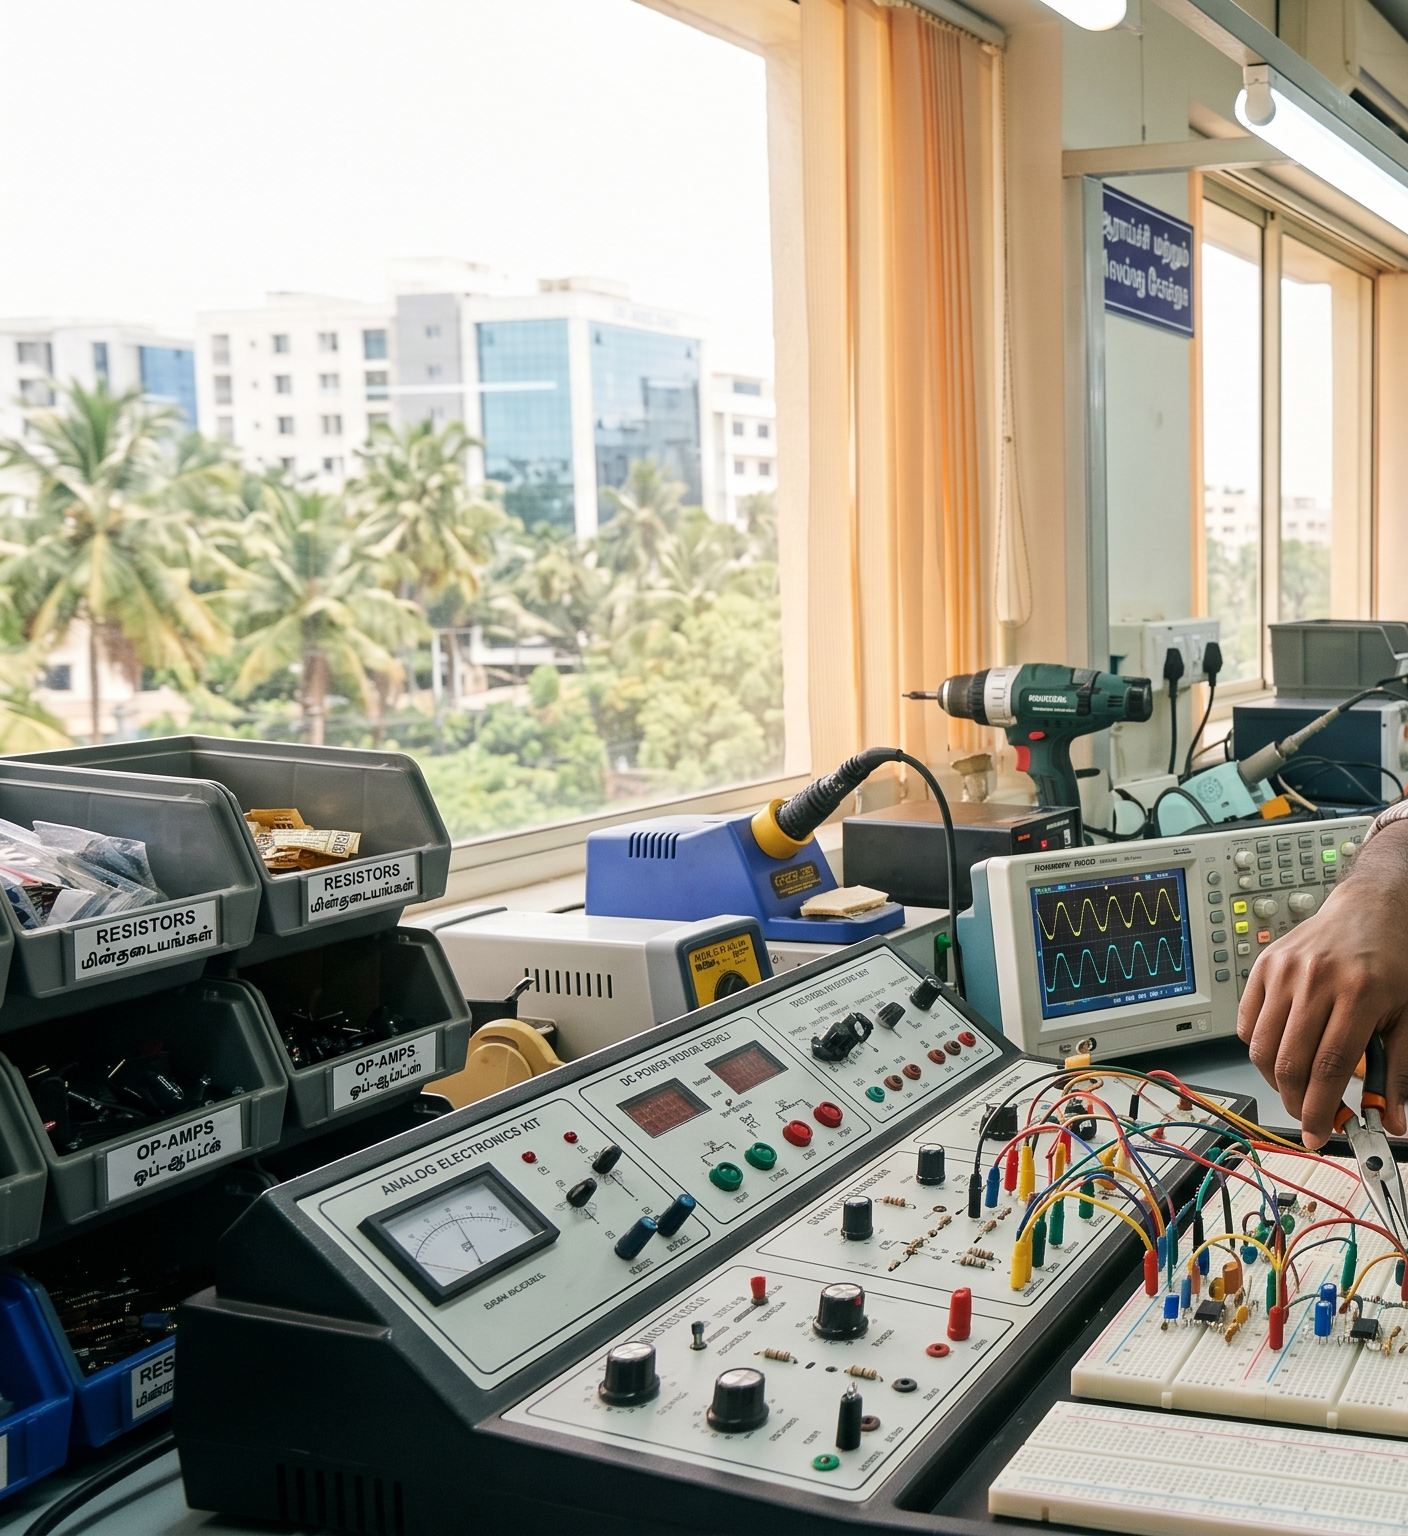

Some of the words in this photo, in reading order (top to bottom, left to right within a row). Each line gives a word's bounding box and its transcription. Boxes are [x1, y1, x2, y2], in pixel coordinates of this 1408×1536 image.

[324, 863, 401, 891] RESISTORS
[96, 910, 196, 945] RESISTORS
[355, 1044, 416, 1076] OP-AMPS
[619, 1074, 637, 1087] DC
[136, 1120, 214, 1160] OP-AMPS
[381, 1164, 438, 1196] ANALOG
[437, 1126, 522, 1170] ELECTRONICS
[520, 1117, 541, 1133] KIT
